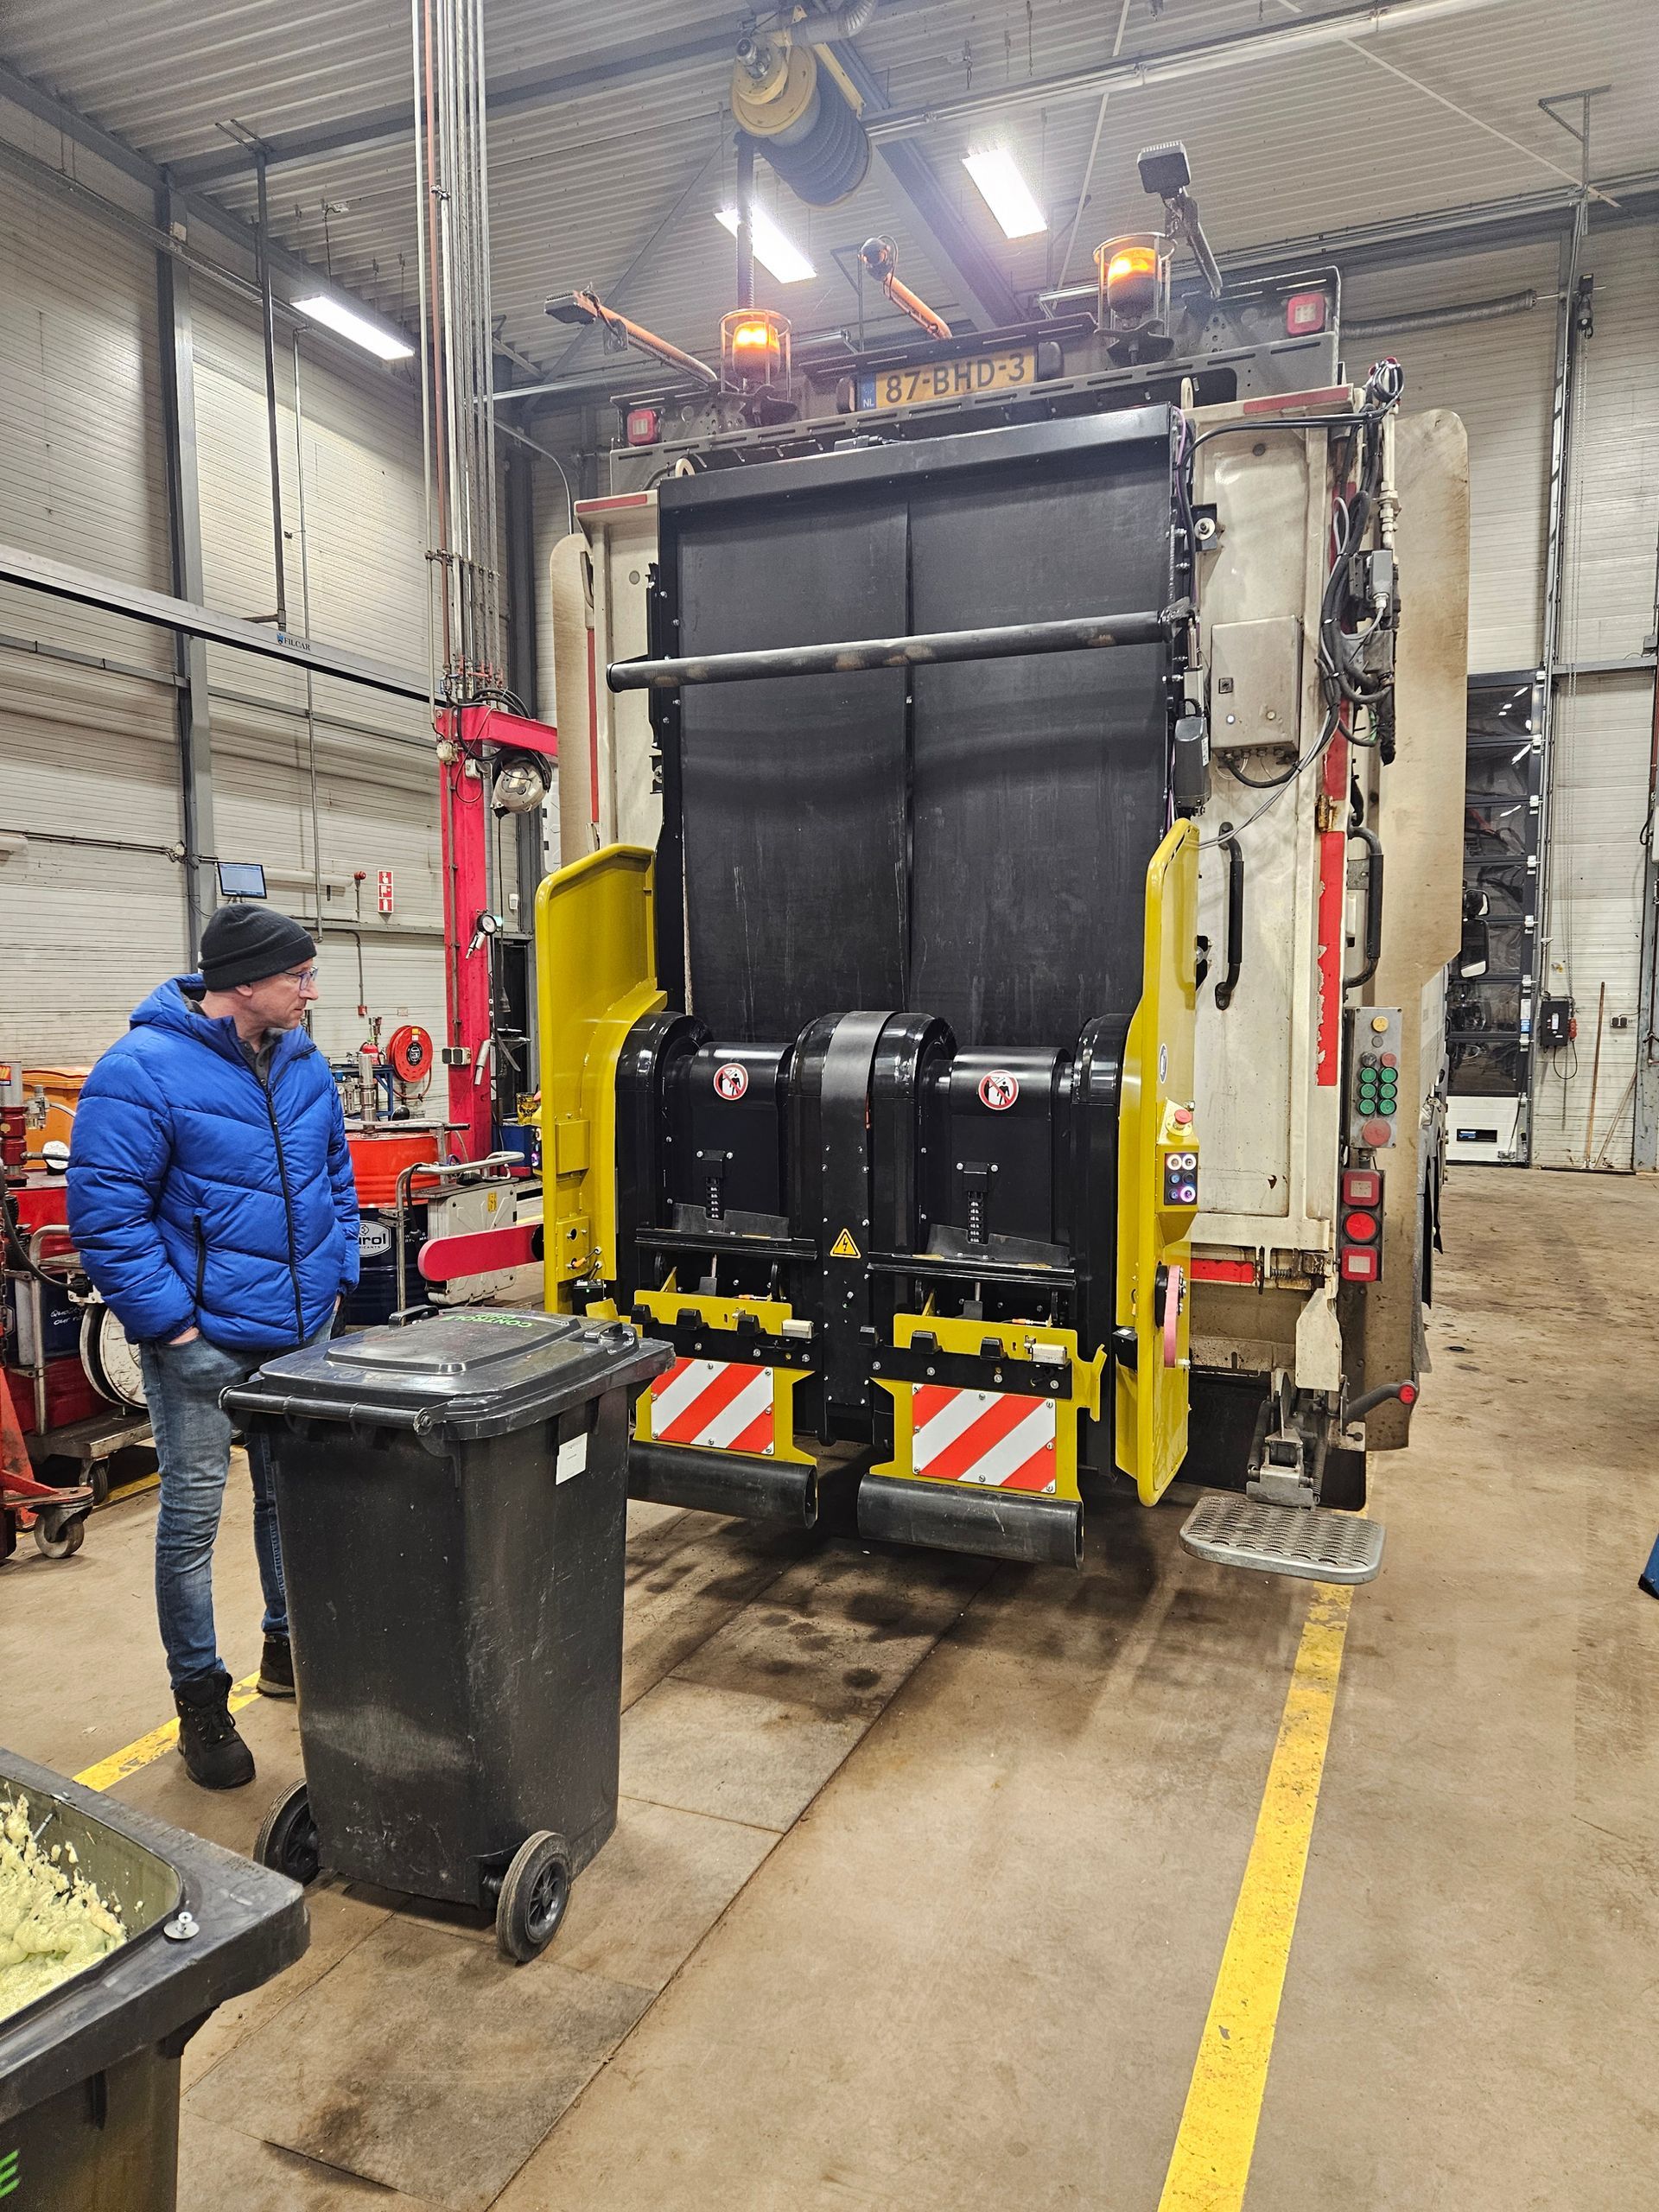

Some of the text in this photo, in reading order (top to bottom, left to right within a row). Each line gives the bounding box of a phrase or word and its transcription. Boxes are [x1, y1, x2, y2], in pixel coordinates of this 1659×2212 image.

[886, 353, 1026, 404] 87-BHD-3
[862, 398, 874, 409] NL
[283, 637, 311, 652] FILCAR
